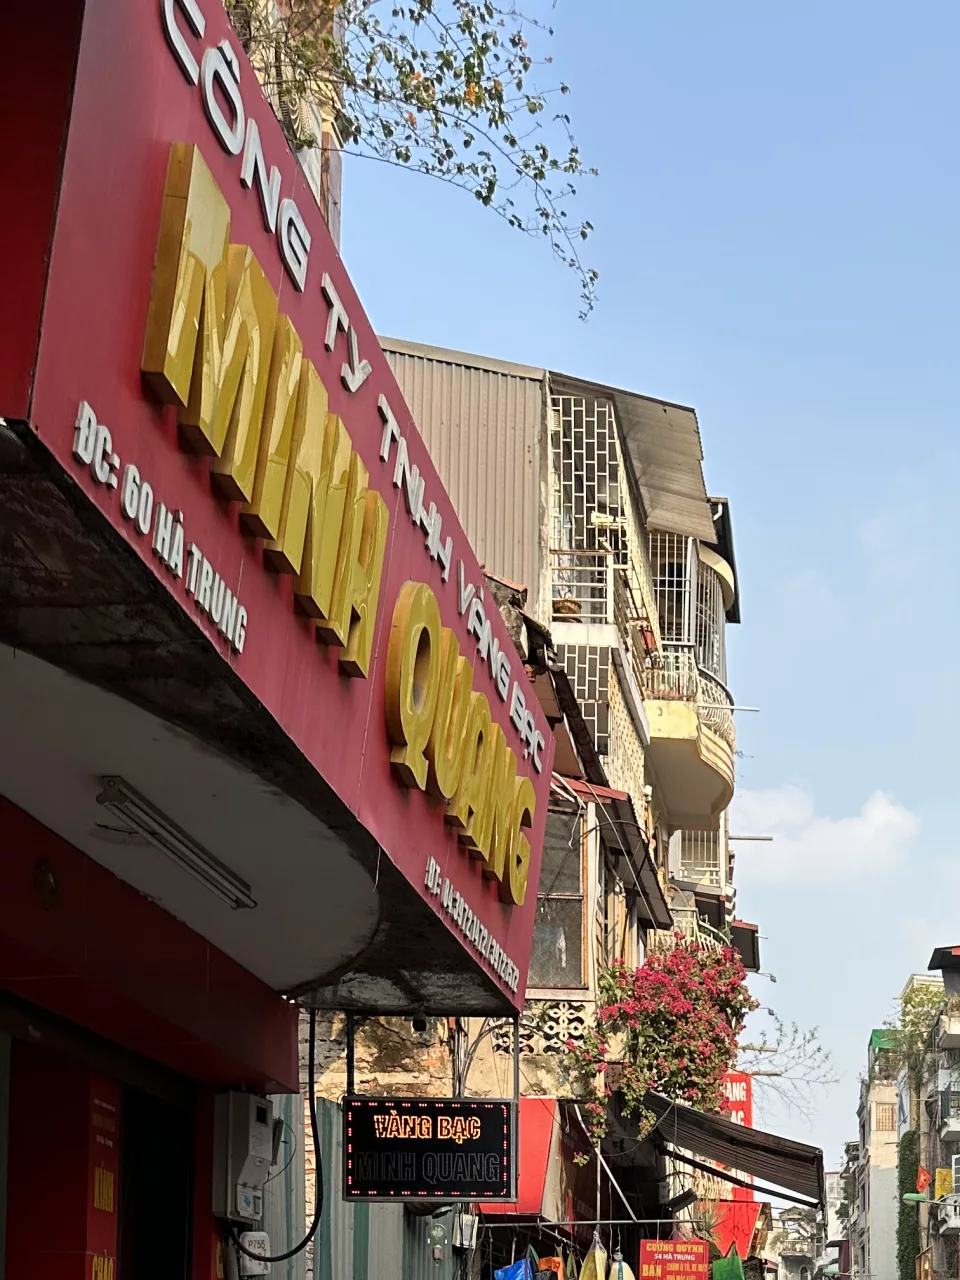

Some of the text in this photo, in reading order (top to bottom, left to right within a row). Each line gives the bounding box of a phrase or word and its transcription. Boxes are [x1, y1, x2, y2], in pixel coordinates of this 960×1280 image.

[73, 401, 248, 655] ĐC: 60 HÀ TRUNG
[141, 142, 536, 906] MINH QUANG
[320, 272, 372, 393] TY
[379, 393, 454, 582] TNHH
[457, 555, 512, 702] VÀNG
[509, 690, 544, 774] BẠC
[355, 1151, 500, 1184] MINH QUANG
[374, 1110, 481, 1144] VÀNG BẠC
[673, 1253, 696, 1261] TRUNG
